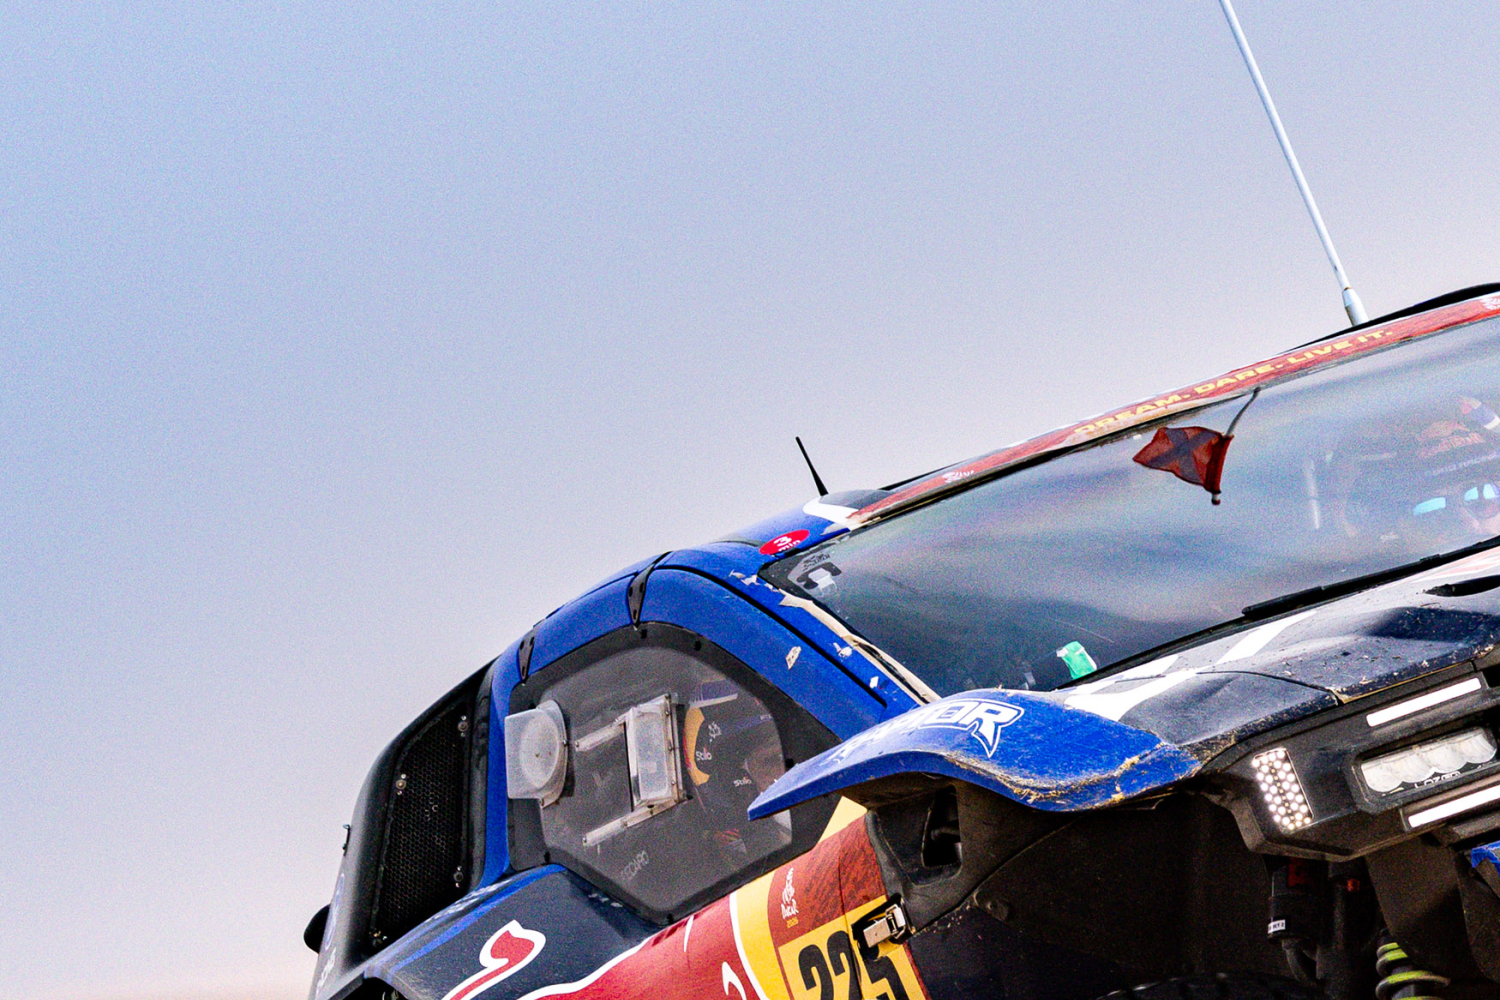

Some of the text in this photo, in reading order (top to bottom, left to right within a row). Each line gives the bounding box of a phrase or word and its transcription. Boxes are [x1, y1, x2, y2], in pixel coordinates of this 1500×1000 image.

[1195, 363, 1284, 395] DARE.
[1287, 341, 1352, 364] LIVE
[773, 536, 793, 547] 3
